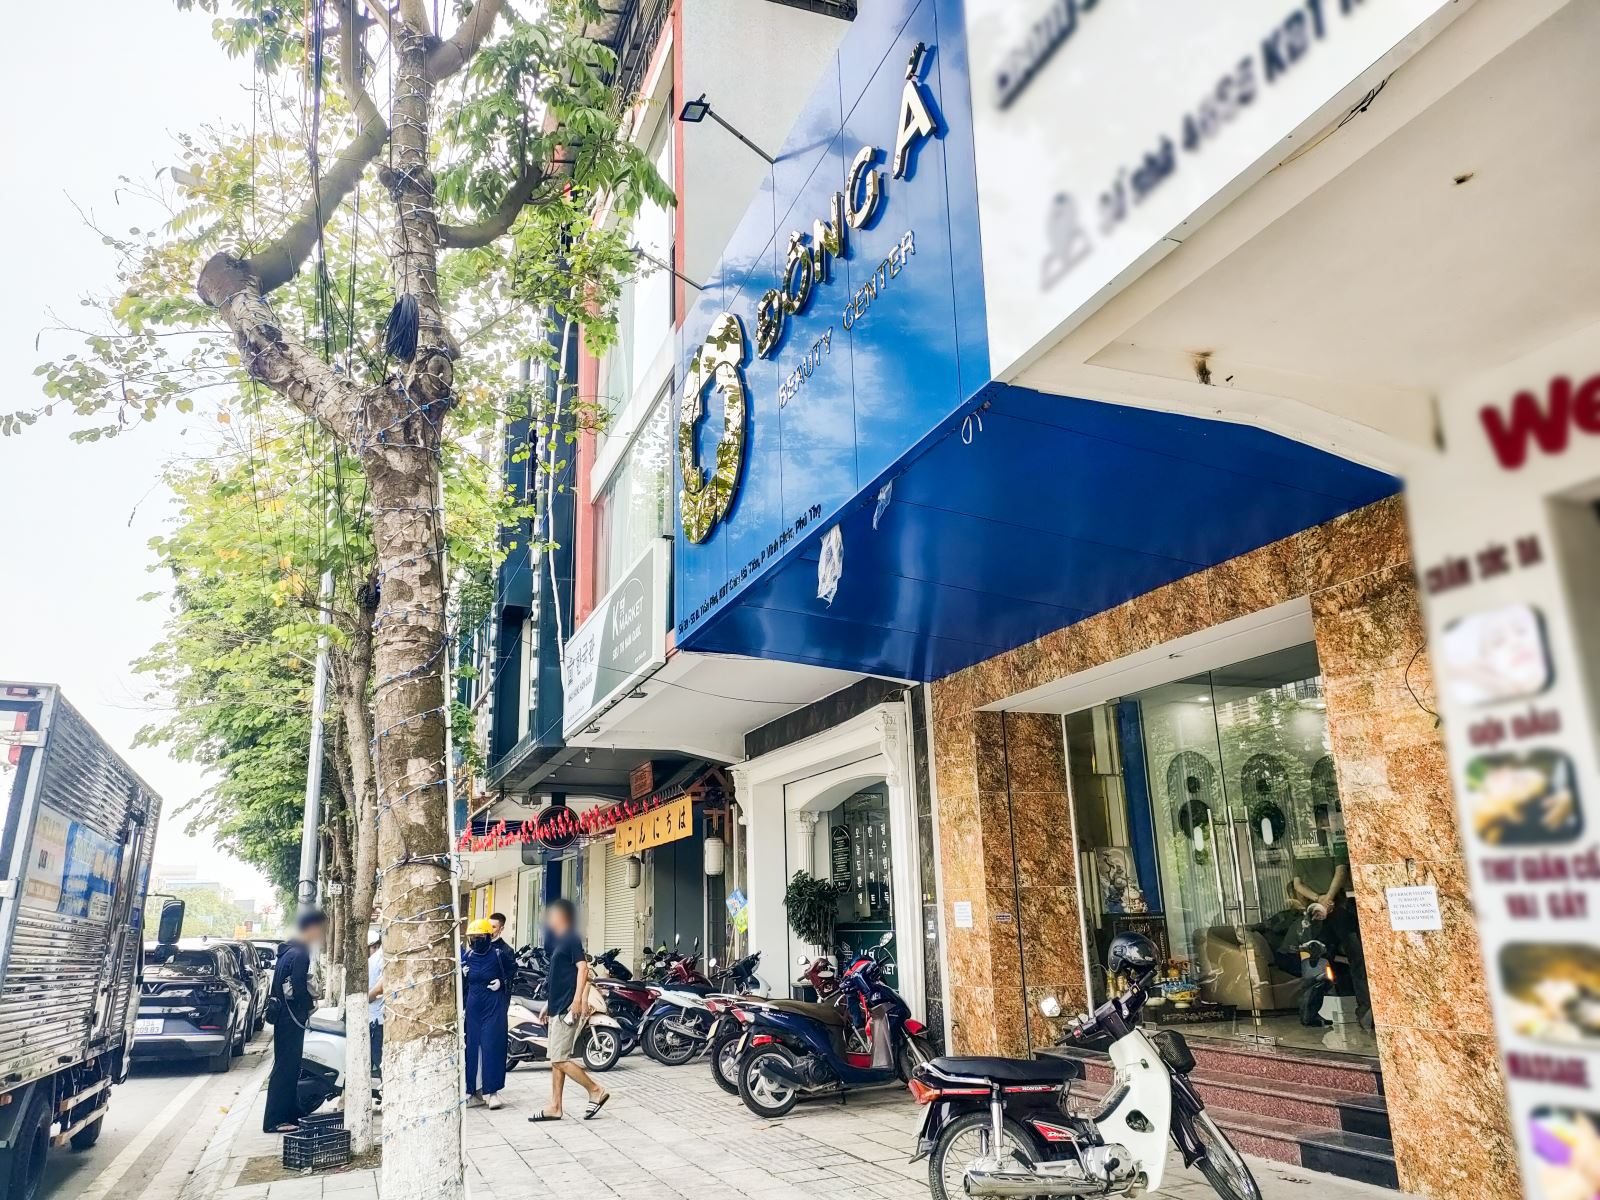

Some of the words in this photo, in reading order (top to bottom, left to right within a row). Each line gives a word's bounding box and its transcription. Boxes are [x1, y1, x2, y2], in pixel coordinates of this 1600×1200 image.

[778, 326, 834, 409] BEAUTY
[842, 229, 916, 331] CENTER
[619, 595, 644, 634] MARKET
[627, 805, 687, 847] こんにちは
